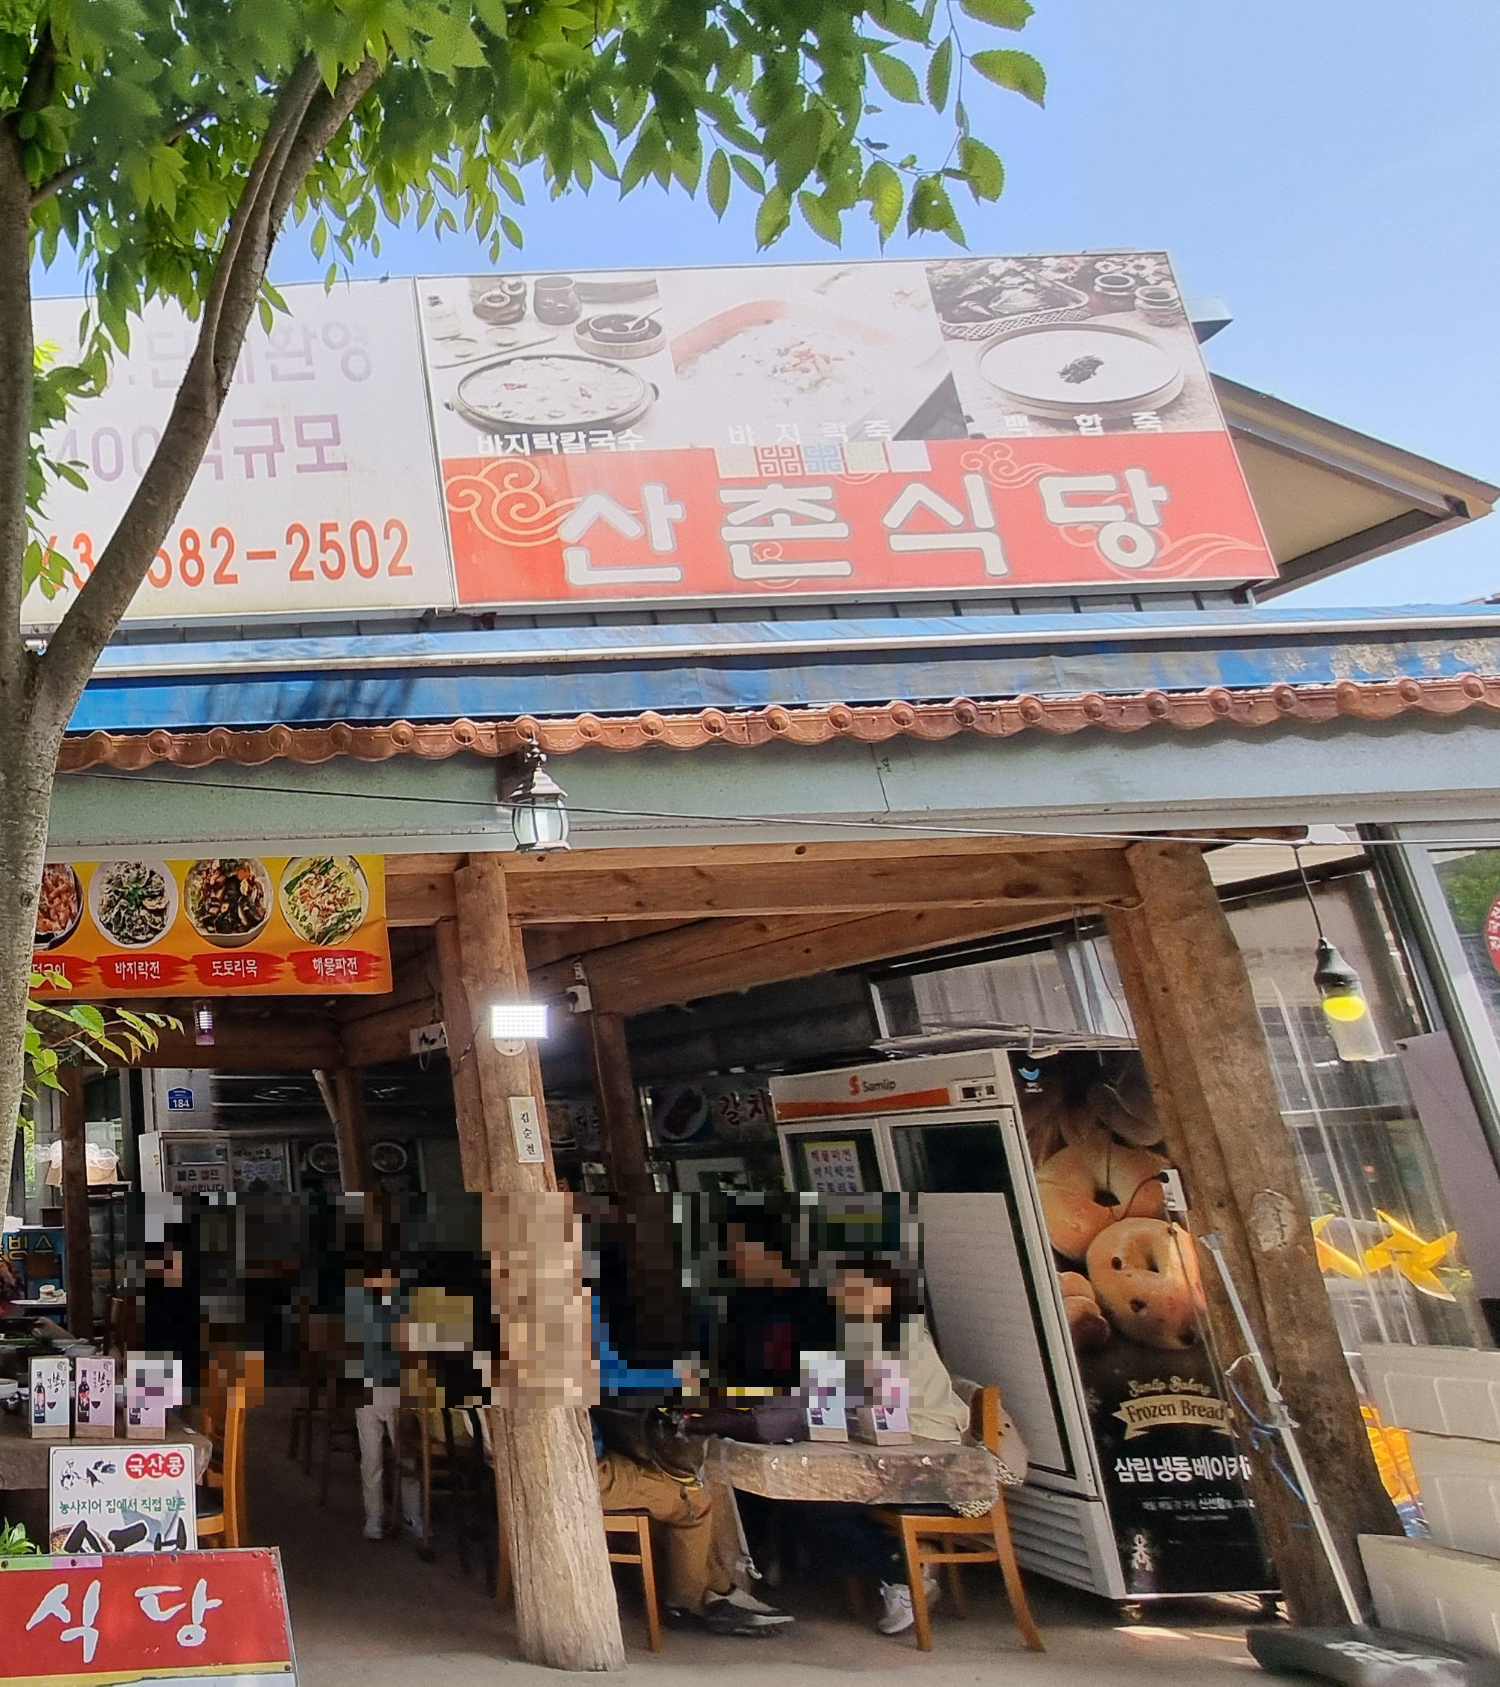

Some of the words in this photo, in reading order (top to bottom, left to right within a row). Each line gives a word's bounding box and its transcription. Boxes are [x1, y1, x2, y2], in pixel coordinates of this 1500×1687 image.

[477, 428, 646, 457] 바지락칼국수
[556, 467, 1170, 590] 산촌식당
[31, 962, 66, 983] 덕구이
[114, 959, 161, 981] 바지락전
[211, 958, 258, 979] 도토리묵
[311, 956, 359, 977] 해물파전
[172, 1098, 190, 1109] 184
[1126, 1402, 1177, 1423] Frozen
[1180, 1400, 1225, 1420] Bread
[127, 1454, 185, 1478] 국산콩
[1113, 1456, 1154, 1483] 삼립
[1152, 1456, 1193, 1483] 냉동
[59, 1499, 102, 1515] 농사지어
[105, 1498, 137, 1514] 집에서
[141, 1496, 162, 1513] 직접
[165, 1496, 187, 1513] 만든
